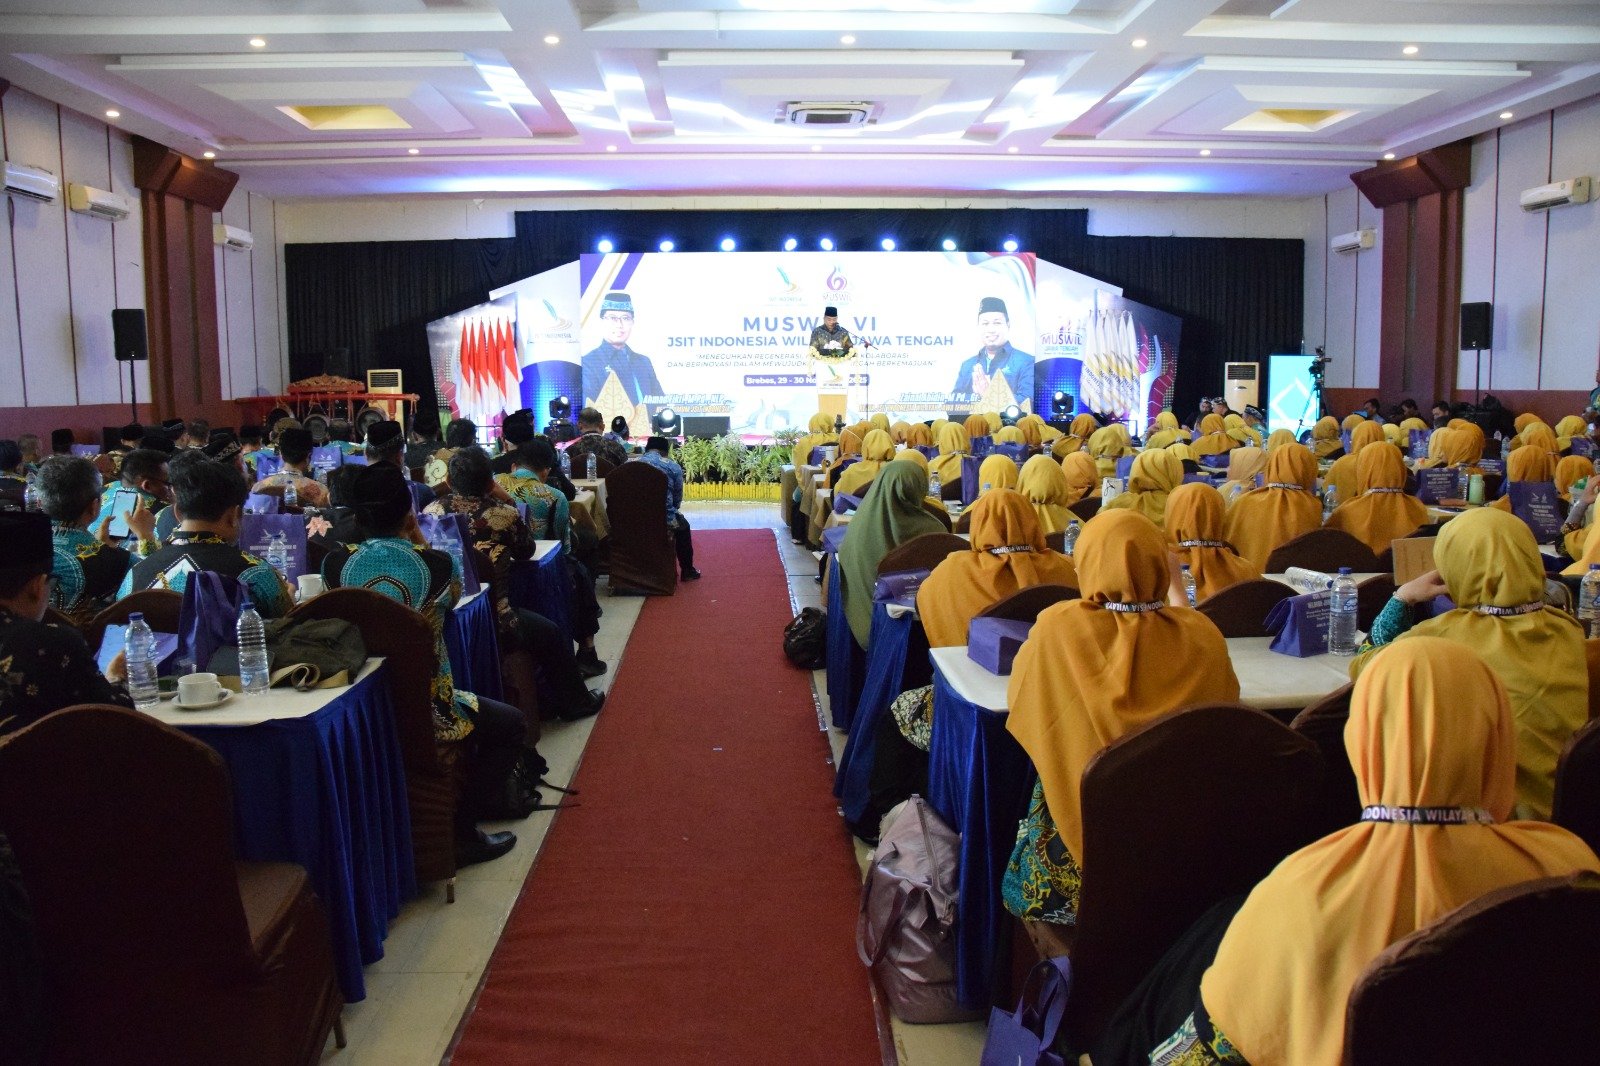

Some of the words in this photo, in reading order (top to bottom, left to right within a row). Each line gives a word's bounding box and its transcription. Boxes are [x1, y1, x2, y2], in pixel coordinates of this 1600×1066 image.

[743, 316, 820, 332] MUSW
[853, 316, 876, 331] VI
[667, 336, 696, 347] JSIT
[700, 336, 778, 347] INDONESIA
[853, 335, 892, 346] JAWA
[896, 335, 954, 346] TENGAH
[1042, 335, 1082, 345] MUSWIL
[746, 376, 777, 385] Brebes,
[1105, 601, 1130, 612] WILAYA
[1361, 806, 1421, 821] NDONESIA
